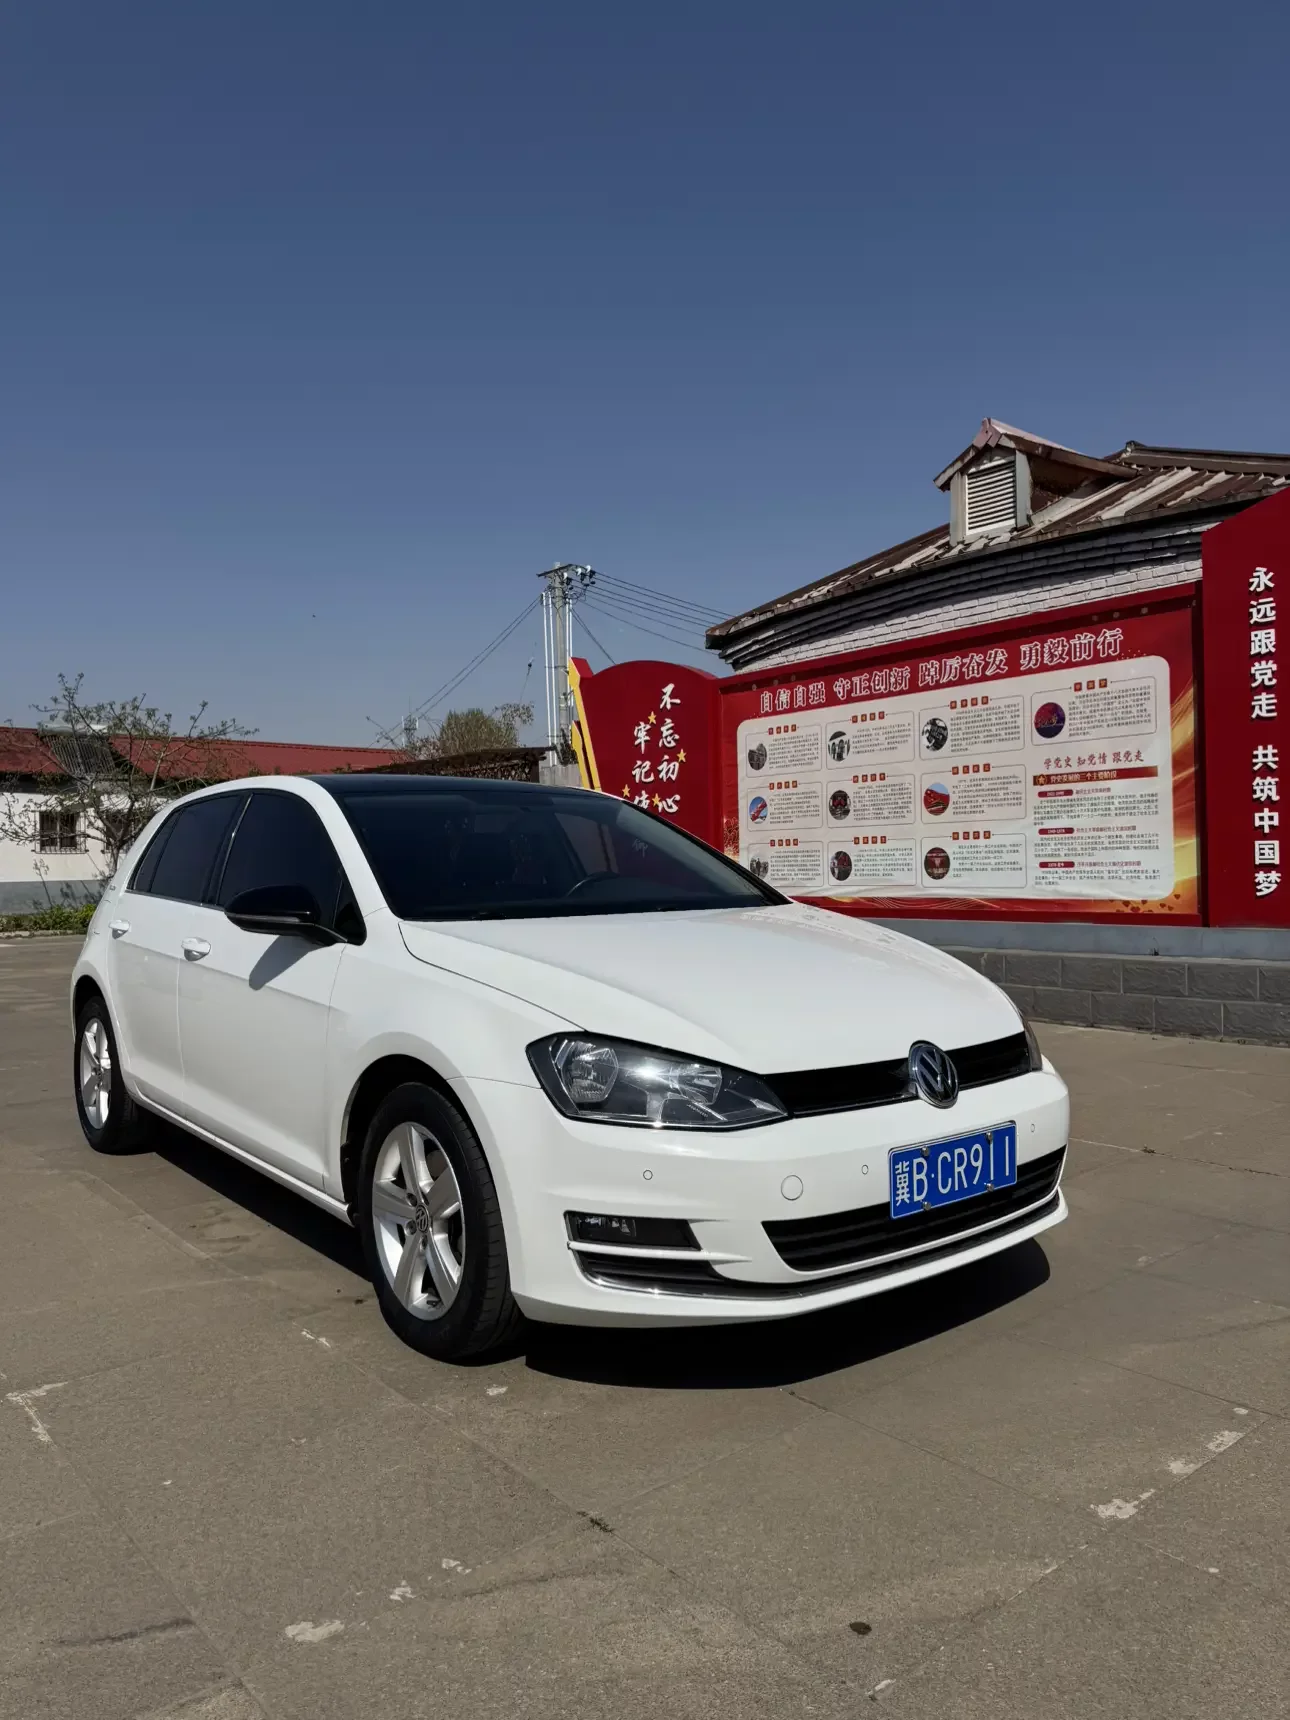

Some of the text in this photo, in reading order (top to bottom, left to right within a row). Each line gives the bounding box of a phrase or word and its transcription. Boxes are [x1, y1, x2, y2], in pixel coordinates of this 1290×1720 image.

[760, 627, 1124, 714] 自信自强 守正创新 踔厉奋发 勇毅前行
[1249, 566, 1278, 719] 永远跟党走
[657, 683, 681, 813] 不忘初心
[1043, 749, 1144, 770] 学党史 知党情 跟党走
[1252, 744, 1281, 896] 共筑中国梦
